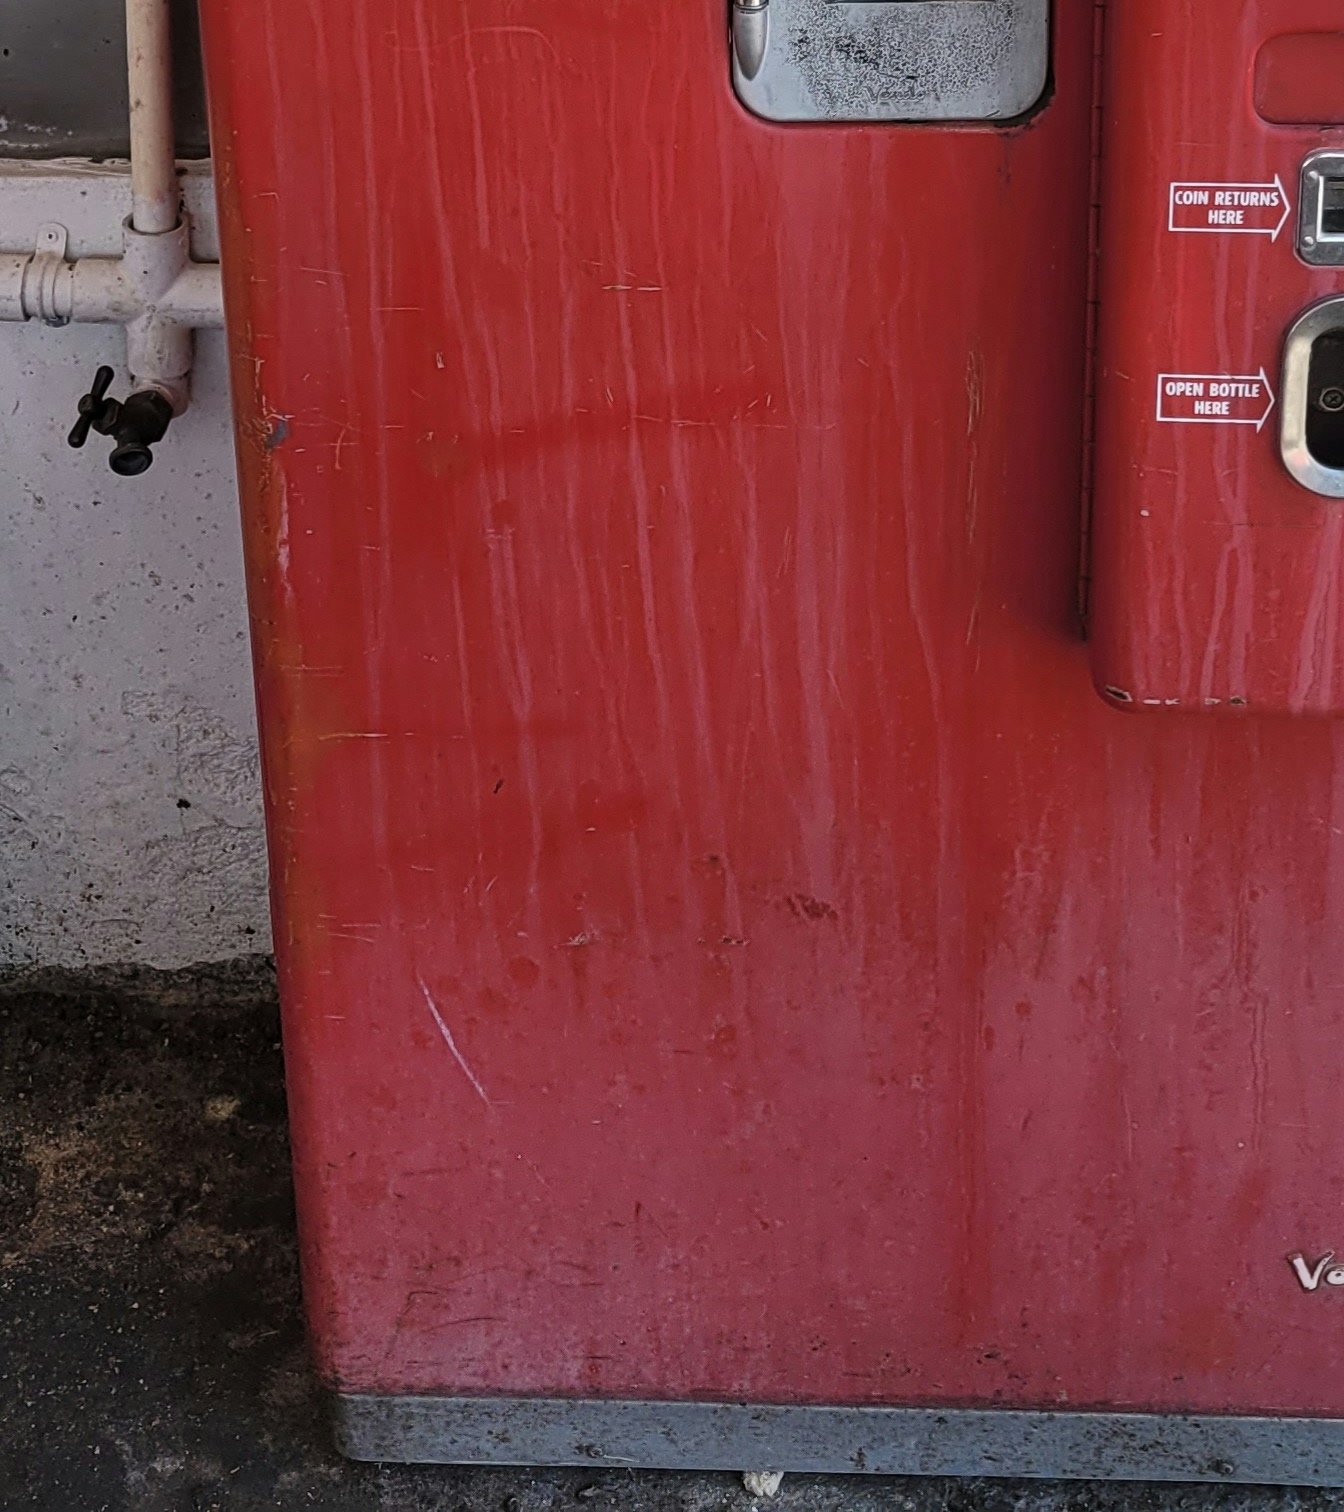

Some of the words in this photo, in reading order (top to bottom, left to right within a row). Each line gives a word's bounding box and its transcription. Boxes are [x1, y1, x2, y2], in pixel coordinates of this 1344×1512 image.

[1174, 191, 1209, 206] COIN
[1214, 191, 1279, 207] RETURNS
[1208, 210, 1244, 225] HERE
[1165, 382, 1204, 397] OPEN
[1209, 382, 1260, 398] BOTTLE
[1194, 401, 1230, 415] HERE
